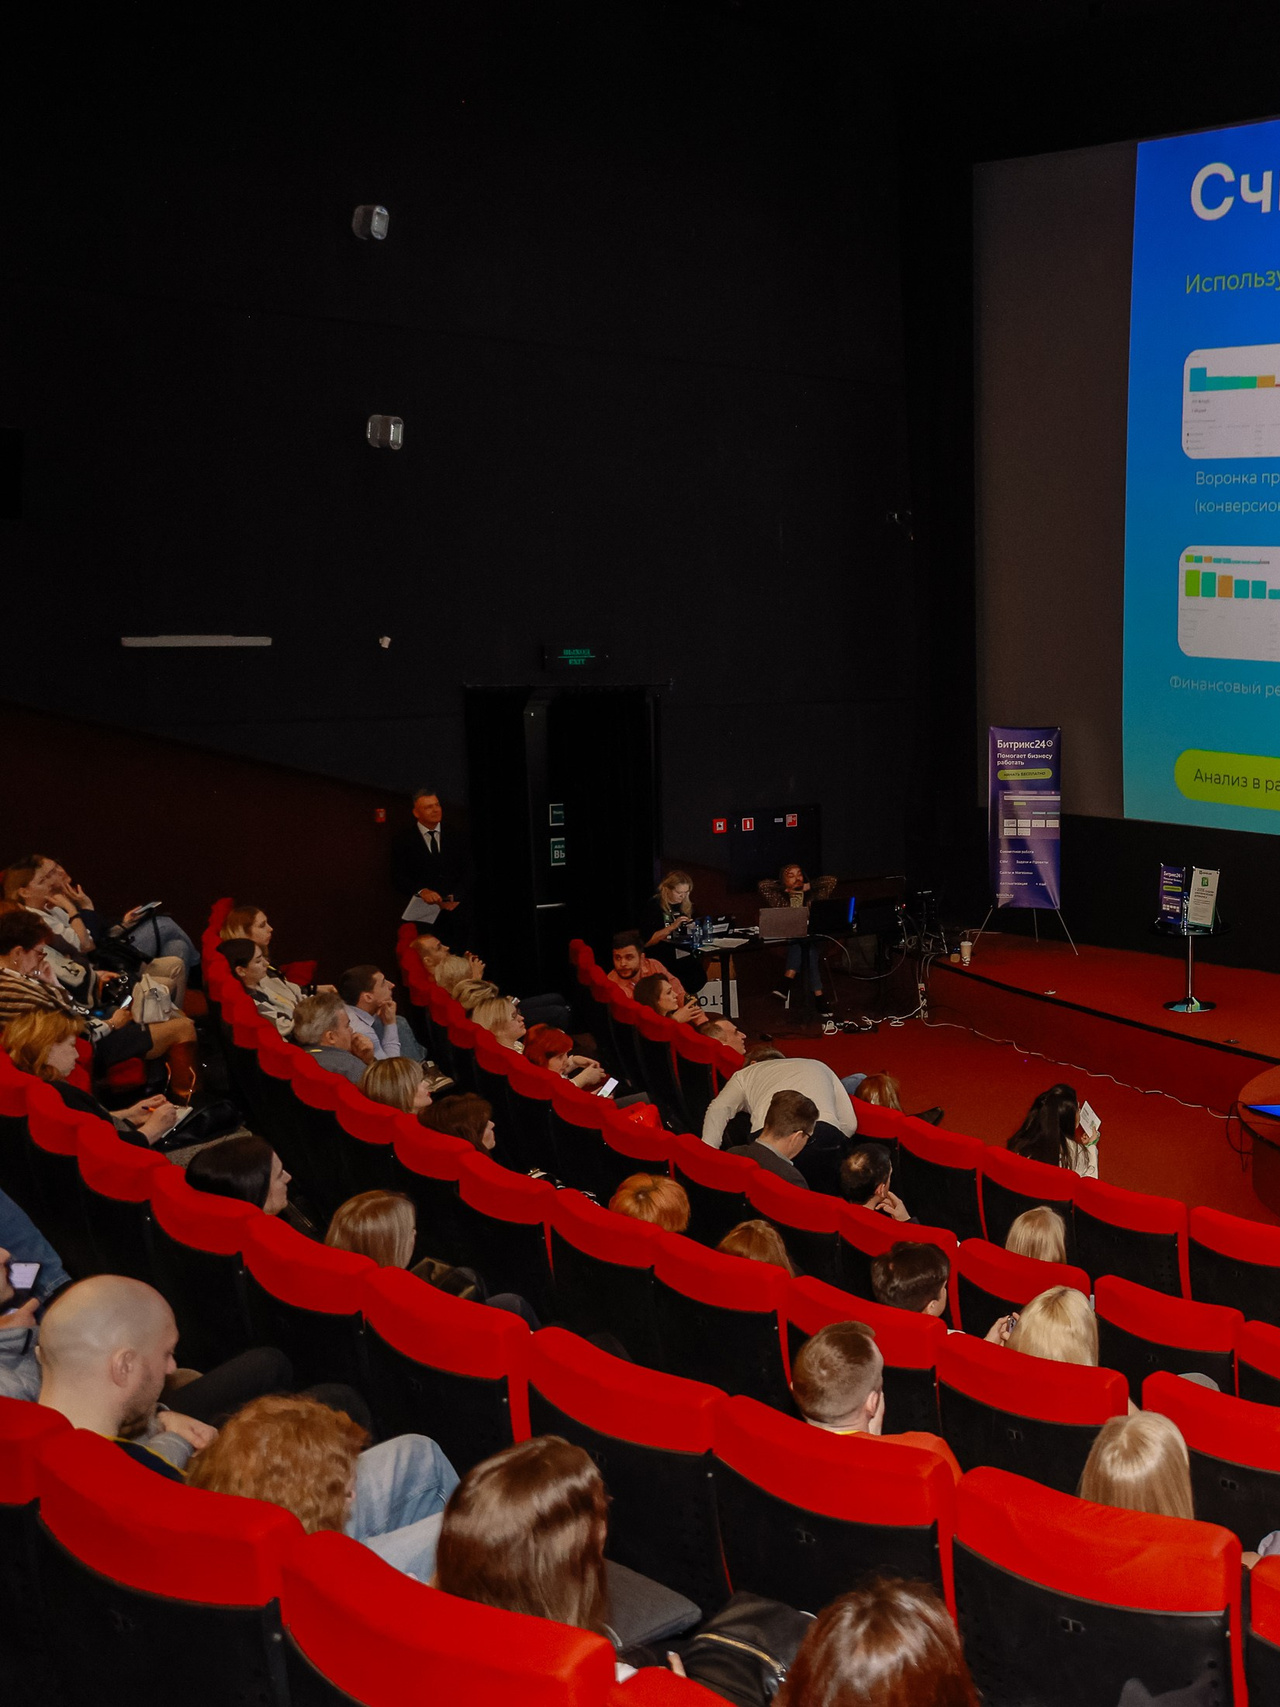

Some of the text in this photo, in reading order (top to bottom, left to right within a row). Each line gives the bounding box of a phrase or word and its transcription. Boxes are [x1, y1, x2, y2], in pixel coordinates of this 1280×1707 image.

[1195, 470, 1257, 487] Воронка
[996, 739, 1046, 751] Битрикс24
[1027, 752, 1053, 760] бизнесу
[1193, 767, 1248, 789] Анализ
[1252, 775, 1261, 789] в
